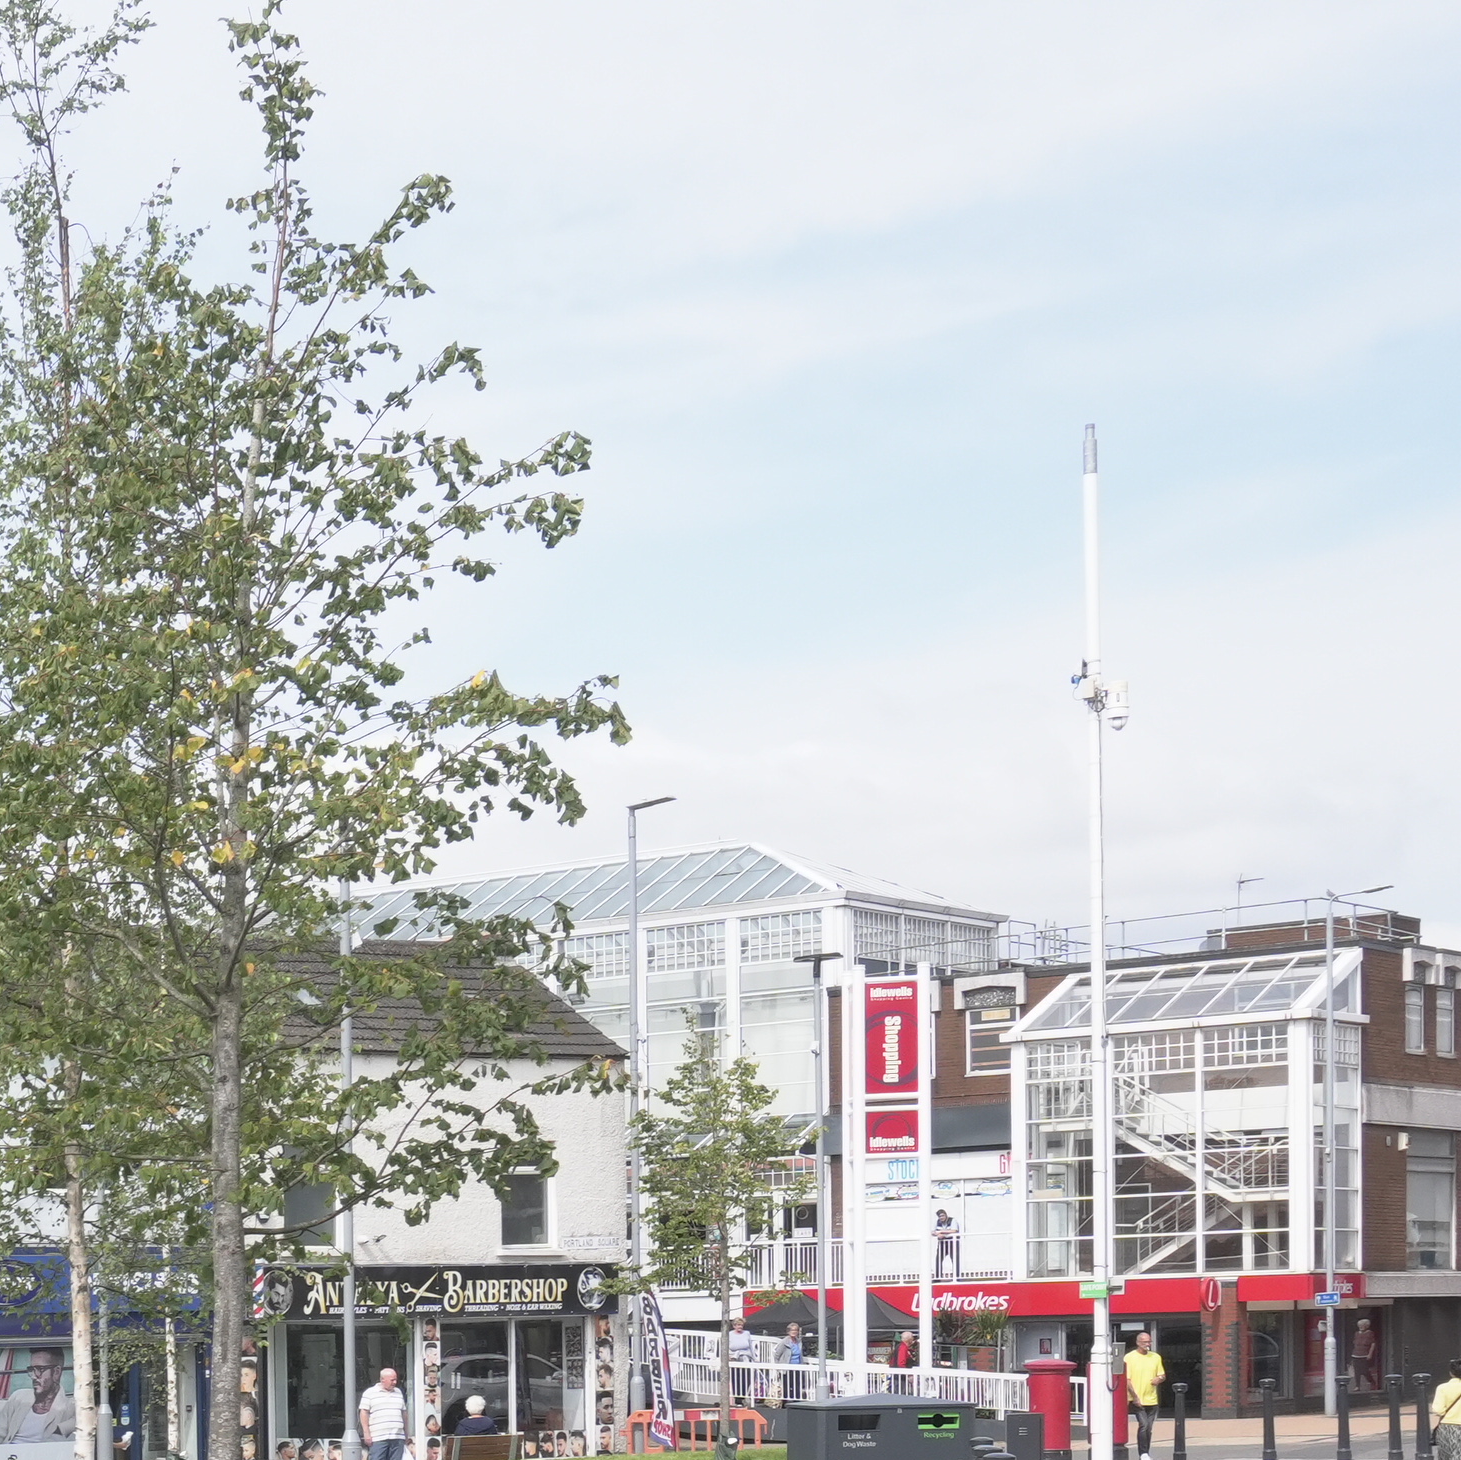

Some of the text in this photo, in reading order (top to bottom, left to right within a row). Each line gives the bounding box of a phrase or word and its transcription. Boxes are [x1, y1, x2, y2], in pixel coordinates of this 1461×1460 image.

[882, 1015, 902, 1083] Shopping
[442, 1270, 568, 1313] BARBERSHOP
[910, 1290, 1010, 1313] Ldbrokes
[847, 1432, 872, 1440] Litter &
[923, 1431, 955, 1440] Recycling
[842, 1440, 877, 1449] Dog Waste
